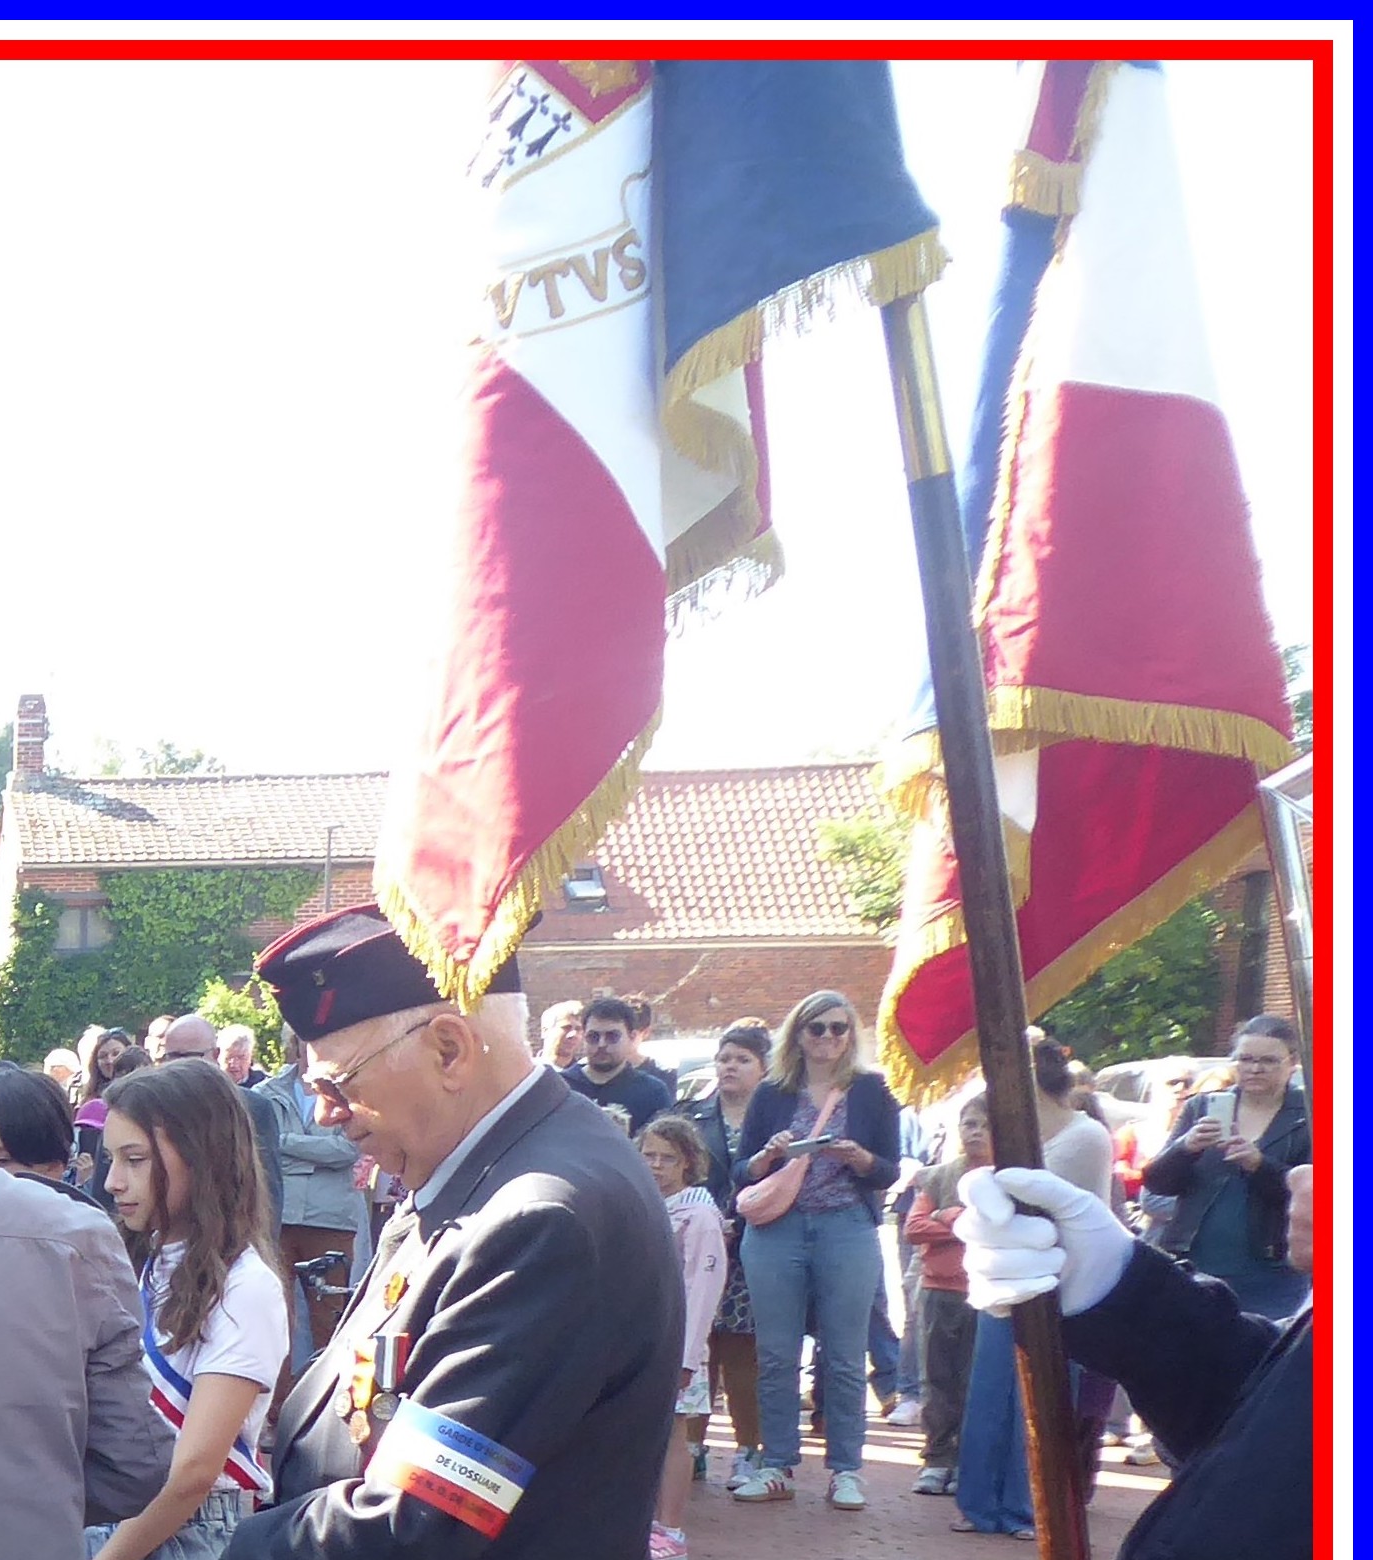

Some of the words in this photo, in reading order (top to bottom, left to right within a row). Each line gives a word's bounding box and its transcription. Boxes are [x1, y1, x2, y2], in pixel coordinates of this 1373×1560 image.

[438, 1425, 472, 1447] GARDE
[436, 1455, 451, 1468] DE
[451, 1462, 501, 1494] L'OSSUAIRE
